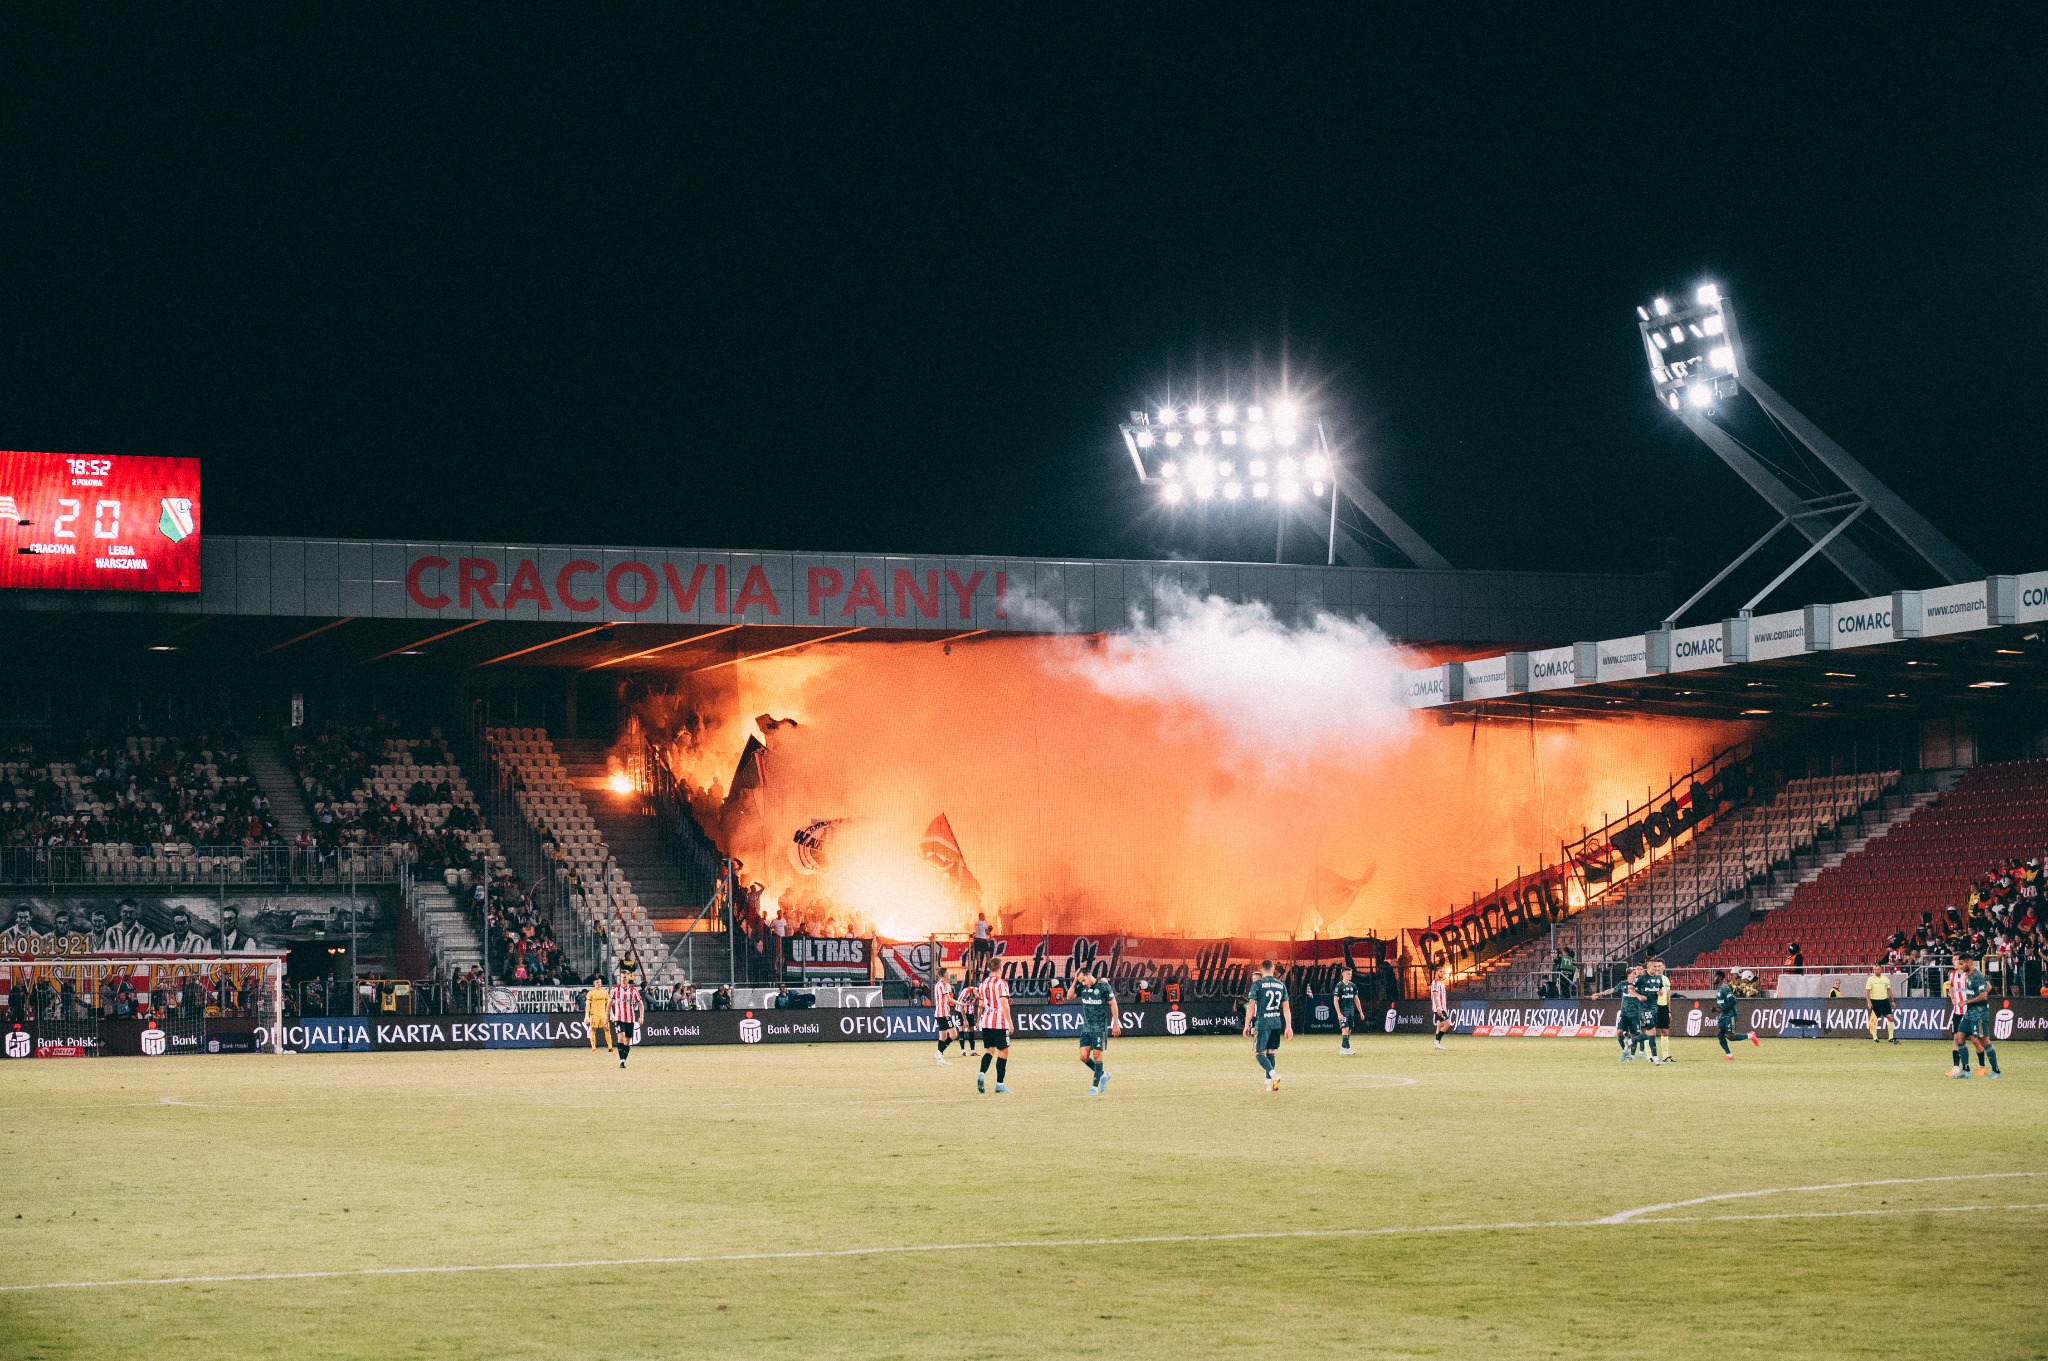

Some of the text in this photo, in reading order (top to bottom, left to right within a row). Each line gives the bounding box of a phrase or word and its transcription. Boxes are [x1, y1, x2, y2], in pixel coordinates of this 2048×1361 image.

[66, 459, 111, 476] 78:52
[54, 498, 121, 539] 2 0
[30, 543, 76, 555] CRACOVIA
[108, 545, 135, 556] LEGIA
[95, 557, 148, 570] WARSZAWA
[405, 556, 1008, 620] CRACOVIA PANY!
[792, 939, 864, 963] ULTRAS
[517, 990, 565, 1002] AKADEMIA
[1265, 990, 1283, 1011] 23
[1191, 1016, 1213, 1027] Bank
[1397, 1014, 1410, 1025] Bank
[1411, 1014, 1424, 1025] Polski
[1487, 1008, 1521, 1027] KARTA
[1524, 1008, 1605, 1027] EKSTRAKLASY
[1826, 1008, 1869, 1029] KARTA
[2017, 1017, 2036, 1029] Bank
[377, 1024, 445, 1044] KARTA
[452, 1020, 592, 1042] EKSTRAKLASY
[647, 1026, 671, 1037] Bank
[673, 1025, 700, 1037] Polski
[767, 1024, 790, 1035] Bank
[793, 1023, 819, 1034] Polski
[172, 1035, 198, 1046] Bank
